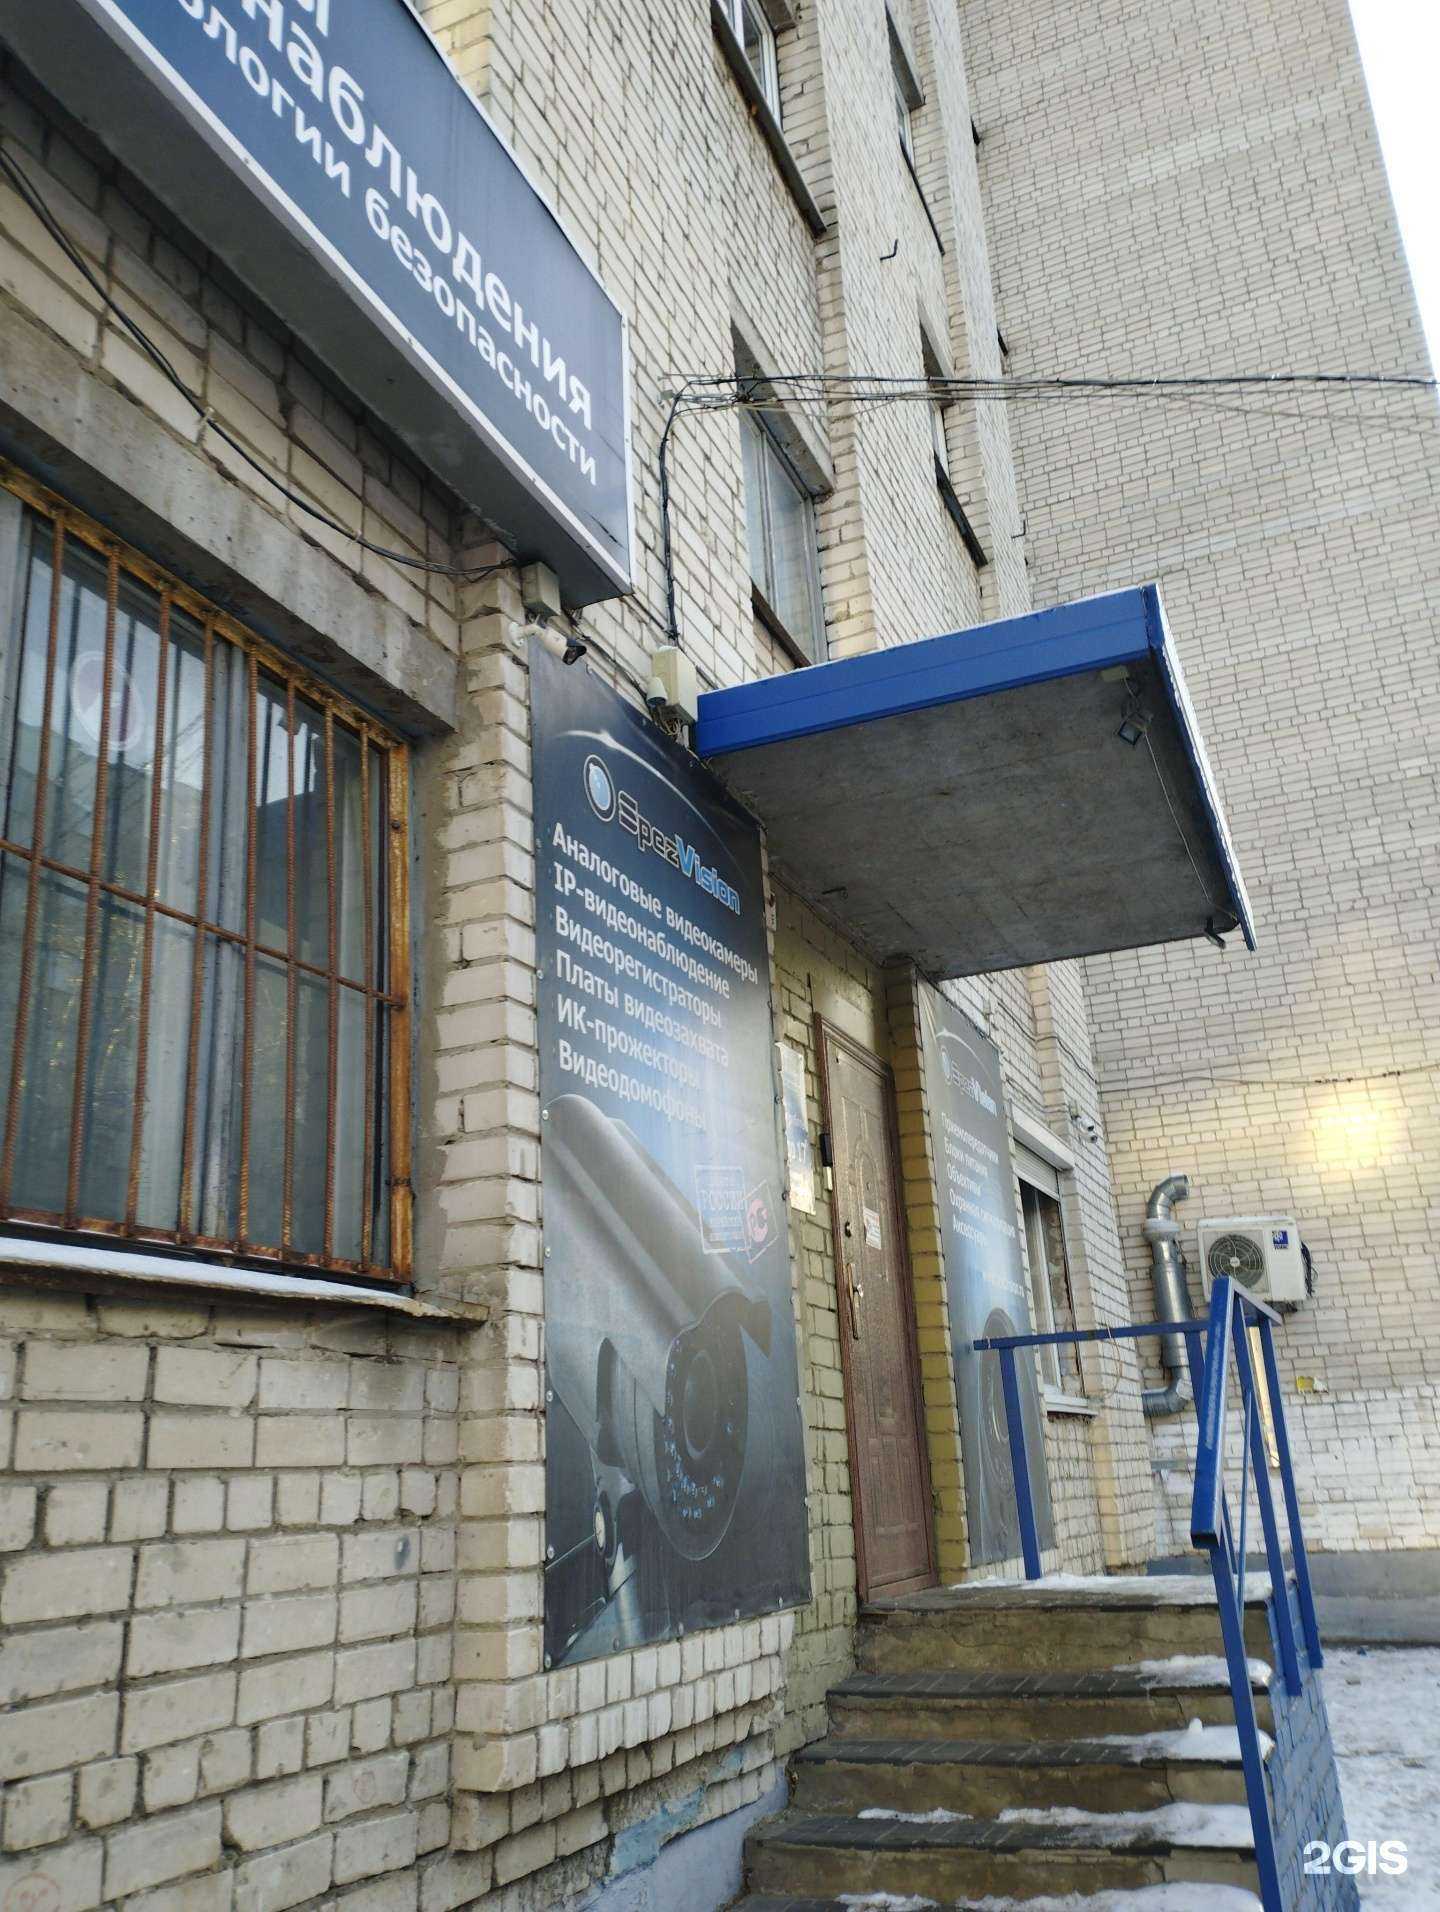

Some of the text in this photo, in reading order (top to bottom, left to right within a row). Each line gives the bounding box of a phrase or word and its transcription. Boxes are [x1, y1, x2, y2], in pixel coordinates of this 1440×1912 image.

[364, 187, 597, 487] безопасности
[552, 822, 759, 985] Аналоговые видеокамеры
[617, 790, 742, 916] SpezVision
[553, 862, 731, 1000] IP-видеонаблюдение
[555, 905, 722, 1029] Видеорегистраторы
[556, 949, 730, 1067] Платы видеозахвата
